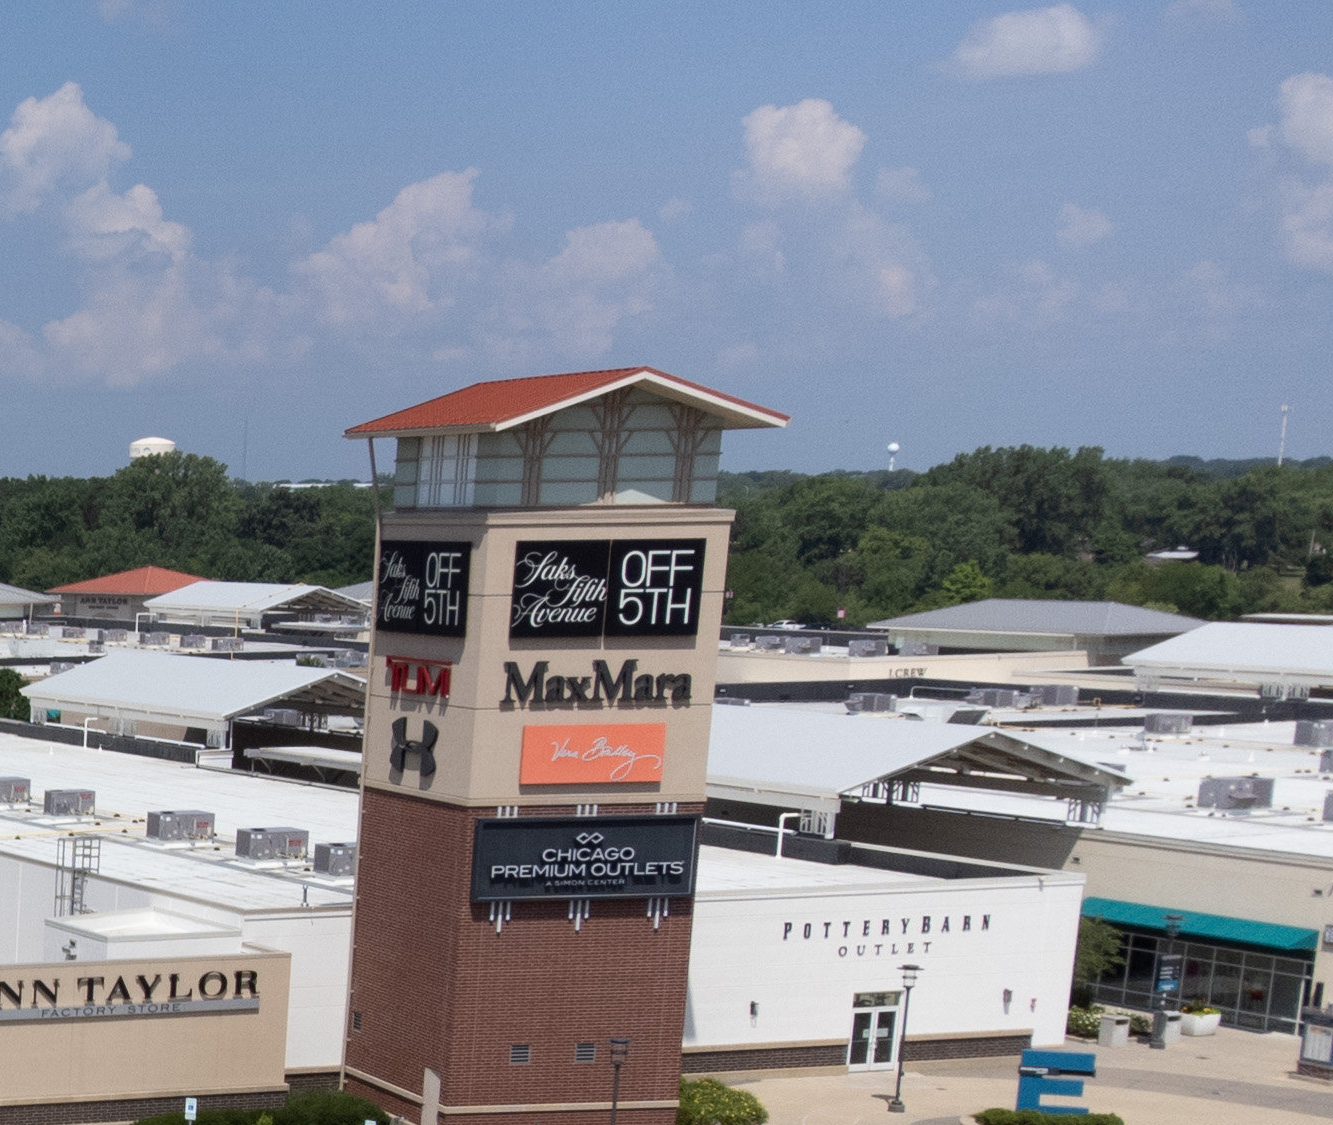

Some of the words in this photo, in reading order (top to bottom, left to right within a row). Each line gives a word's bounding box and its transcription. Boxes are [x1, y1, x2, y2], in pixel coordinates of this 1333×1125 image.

[425, 552, 462, 589] OFF
[516, 551, 576, 589] Saks
[622, 550, 695, 587] OFF
[424, 588, 460, 626] 5TH
[512, 593, 597, 628] Avenue
[619, 588, 691, 625] 5TH
[550, 737, 580, 762] Vera
[583, 737, 662, 781] Bradley
[491, 863, 586, 878] PREMIUM
[542, 847, 635, 862] CHICAGO
[838, 942, 932, 958] OUTLET
[77, 970, 260, 1006] TAYLOR
[41, 1005, 116, 1018] FACTORY
[128, 1003, 182, 1014] STORE
